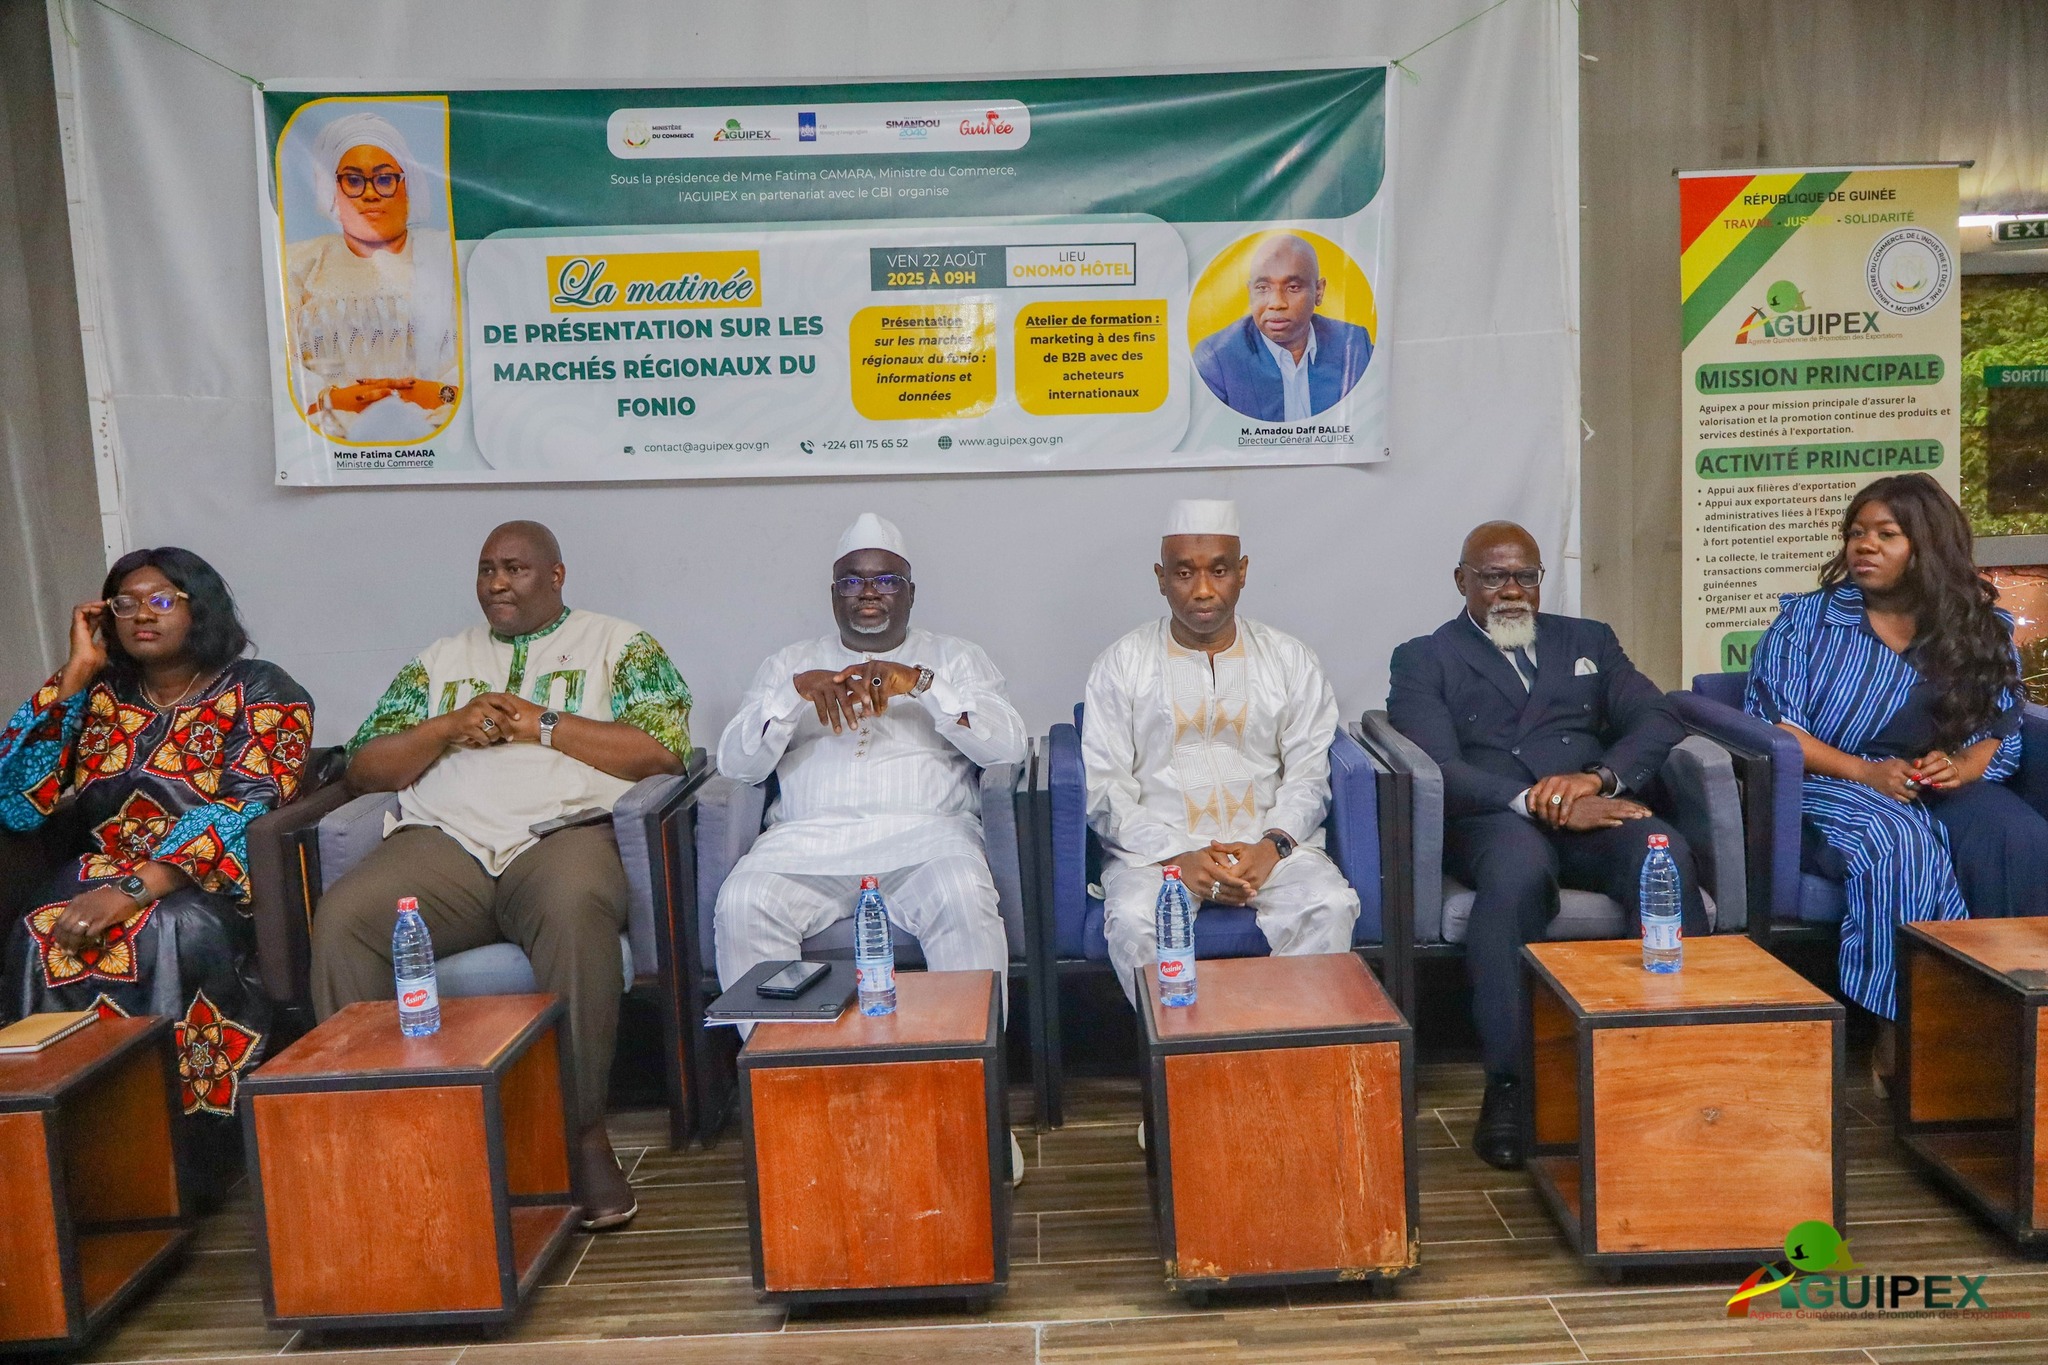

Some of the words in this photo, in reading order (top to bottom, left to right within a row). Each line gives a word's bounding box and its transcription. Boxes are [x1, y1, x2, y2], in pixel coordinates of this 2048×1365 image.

[886, 120, 940, 128] SIMANDOU
[960, 112, 1014, 135] Guinée
[714, 128, 771, 141] AGUIPEX
[899, 128, 927, 136] 2040
[610, 174, 639, 184] Sous
[642, 173, 652, 184] la
[655, 173, 720, 186] présidence
[722, 172, 738, 182] de
[741, 172, 772, 181] Mme
[775, 170, 816, 181] Fatima
[820, 168, 876, 180] CAMARA,
[879, 167, 927, 178] Ministre
[930, 166, 945, 177] du
[948, 166, 1017, 177] Commerce,
[679, 191, 738, 202] l'AGUIPEX
[740, 192, 756, 201] en
[759, 189, 825, 202] partenariat
[828, 190, 855, 199] avec
[858, 187, 868, 198] le
[871, 187, 892, 198] CBI
[898, 186, 949, 198] organise
[1744, 192, 1827, 205] RÉPUBLIQUE
[1829, 191, 1845, 202] DE
[1850, 190, 1896, 201] GUINÉE
[1844, 210, 1914, 224] SOLIDARITÉ
[886, 254, 918, 268] VEN
[923, 254, 940, 267] 22
[943, 250, 987, 267] AOÛT
[1059, 251, 1086, 262] LIEU
[1013, 263, 1076, 277] ONOMO
[1080, 260, 1132, 276] HÔTEL
[554, 260, 616, 306] La
[627, 270, 754, 302] matinée
[887, 272, 925, 286] 2025
[928, 270, 941, 284] À
[944, 271, 976, 284] 09H
[1026, 315, 1068, 326] Atelier
[1071, 315, 1087, 325] de
[1090, 313, 1152, 324] formation
[1735, 306, 1880, 344] AGUIPEX
[484, 324, 518, 344] DE
[525, 318, 713, 343] PRÉSENTATION
[720, 318, 771, 338] SUR
[779, 316, 823, 336] LES
[874, 338, 894, 346] sur
[897, 336, 915, 346] les
[1030, 333, 1094, 346] marketing
[1097, 333, 1104, 343] à
[1108, 332, 1130, 342] des
[1133, 332, 1155, 342] fins
[862, 354, 924, 367] régionaux
[927, 353, 944, 366] du
[1043, 352, 1058, 363] de
[1062, 352, 1086, 362] B2B
[1090, 354, 1118, 362] avec
[1121, 351, 1143, 360] des
[494, 356, 616, 382] MARCHÉS
[623, 355, 772, 379] RÉGIONAUX
[779, 355, 816, 374] DU
[1063, 370, 1124, 380] acheteurs
[1700, 367, 1797, 389] MISSION
[1807, 361, 1939, 384] PRINCIPALE
[876, 372, 956, 384] informations
[959, 373, 972, 382] et
[898, 391, 951, 401] données
[1049, 388, 1139, 399] internationaux
[617, 396, 696, 417] FONIO
[1699, 404, 1737, 415] Aguipex
[1748, 404, 1770, 413] pour
[1772, 400, 1810, 409] mission
[1812, 398, 1859, 410] principale
[1862, 397, 1905, 405] d'assurer
[1699, 417, 1755, 426] valorisation
[1770, 415, 1778, 423] la
[1781, 413, 1832, 425] promotion
[1834, 411, 1877, 420] continue
[1879, 410, 1895, 418] des
[1897, 408, 1938, 419] produits
[1254, 427, 1293, 435] Amadou
[1296, 426, 1316, 434] Daff
[1699, 431, 1737, 440] services
[1739, 428, 1779, 438] destinés
[1781, 428, 1787, 436] à
[1790, 426, 1854, 437] l'exportation.
[822, 441, 846, 450] +224
[849, 440, 863, 449] 611
[866, 440, 878, 448] 75
[881, 439, 894, 448] 65
[896, 439, 908, 448] 52
[958, 436, 1063, 447] www.aguipex.gov.gn
[1238, 437, 1278, 445] Directeur
[1279, 435, 1312, 444] Général
[1314, 435, 1354, 444] AGUIPEX
[360, 450, 392, 458] Fatima
[394, 449, 435, 458] CAMARA
[644, 442, 769, 453] contact@aguipex.gov.gn
[337, 460, 372, 468] Ministre
[387, 459, 434, 468] Commerce
[1699, 448, 1798, 474] ACTIVITÉ
[1807, 446, 1939, 469] PRINCIPALE
[1707, 486, 1735, 496] Appui
[1757, 483, 1790, 492] filières
[1792, 481, 1856, 492] d'exportation
[1705, 498, 1732, 509] Appui
[1754, 496, 1817, 507] exportateurs
[1705, 510, 1779, 521] administratives
[1782, 509, 1804, 517] liées
[1806, 508, 1812, 516] à
[1703, 523, 1766, 533] Identification
[1788, 520, 1829, 529] marchés
[1703, 538, 1709, 546] à
[1731, 535, 1774, 547] potentiel
[1777, 533, 1829, 544] exportable
[1719, 554, 1757, 562] collecte,
[1771, 551, 1824, 560] traitement
[1703, 566, 1762, 576] transactions
[1703, 580, 1757, 591] guinéennes
[1705, 593, 1751, 604] Organiser
[1706, 606, 1747, 615] PME/PMI
[1705, 619, 1771, 628] commerciales
